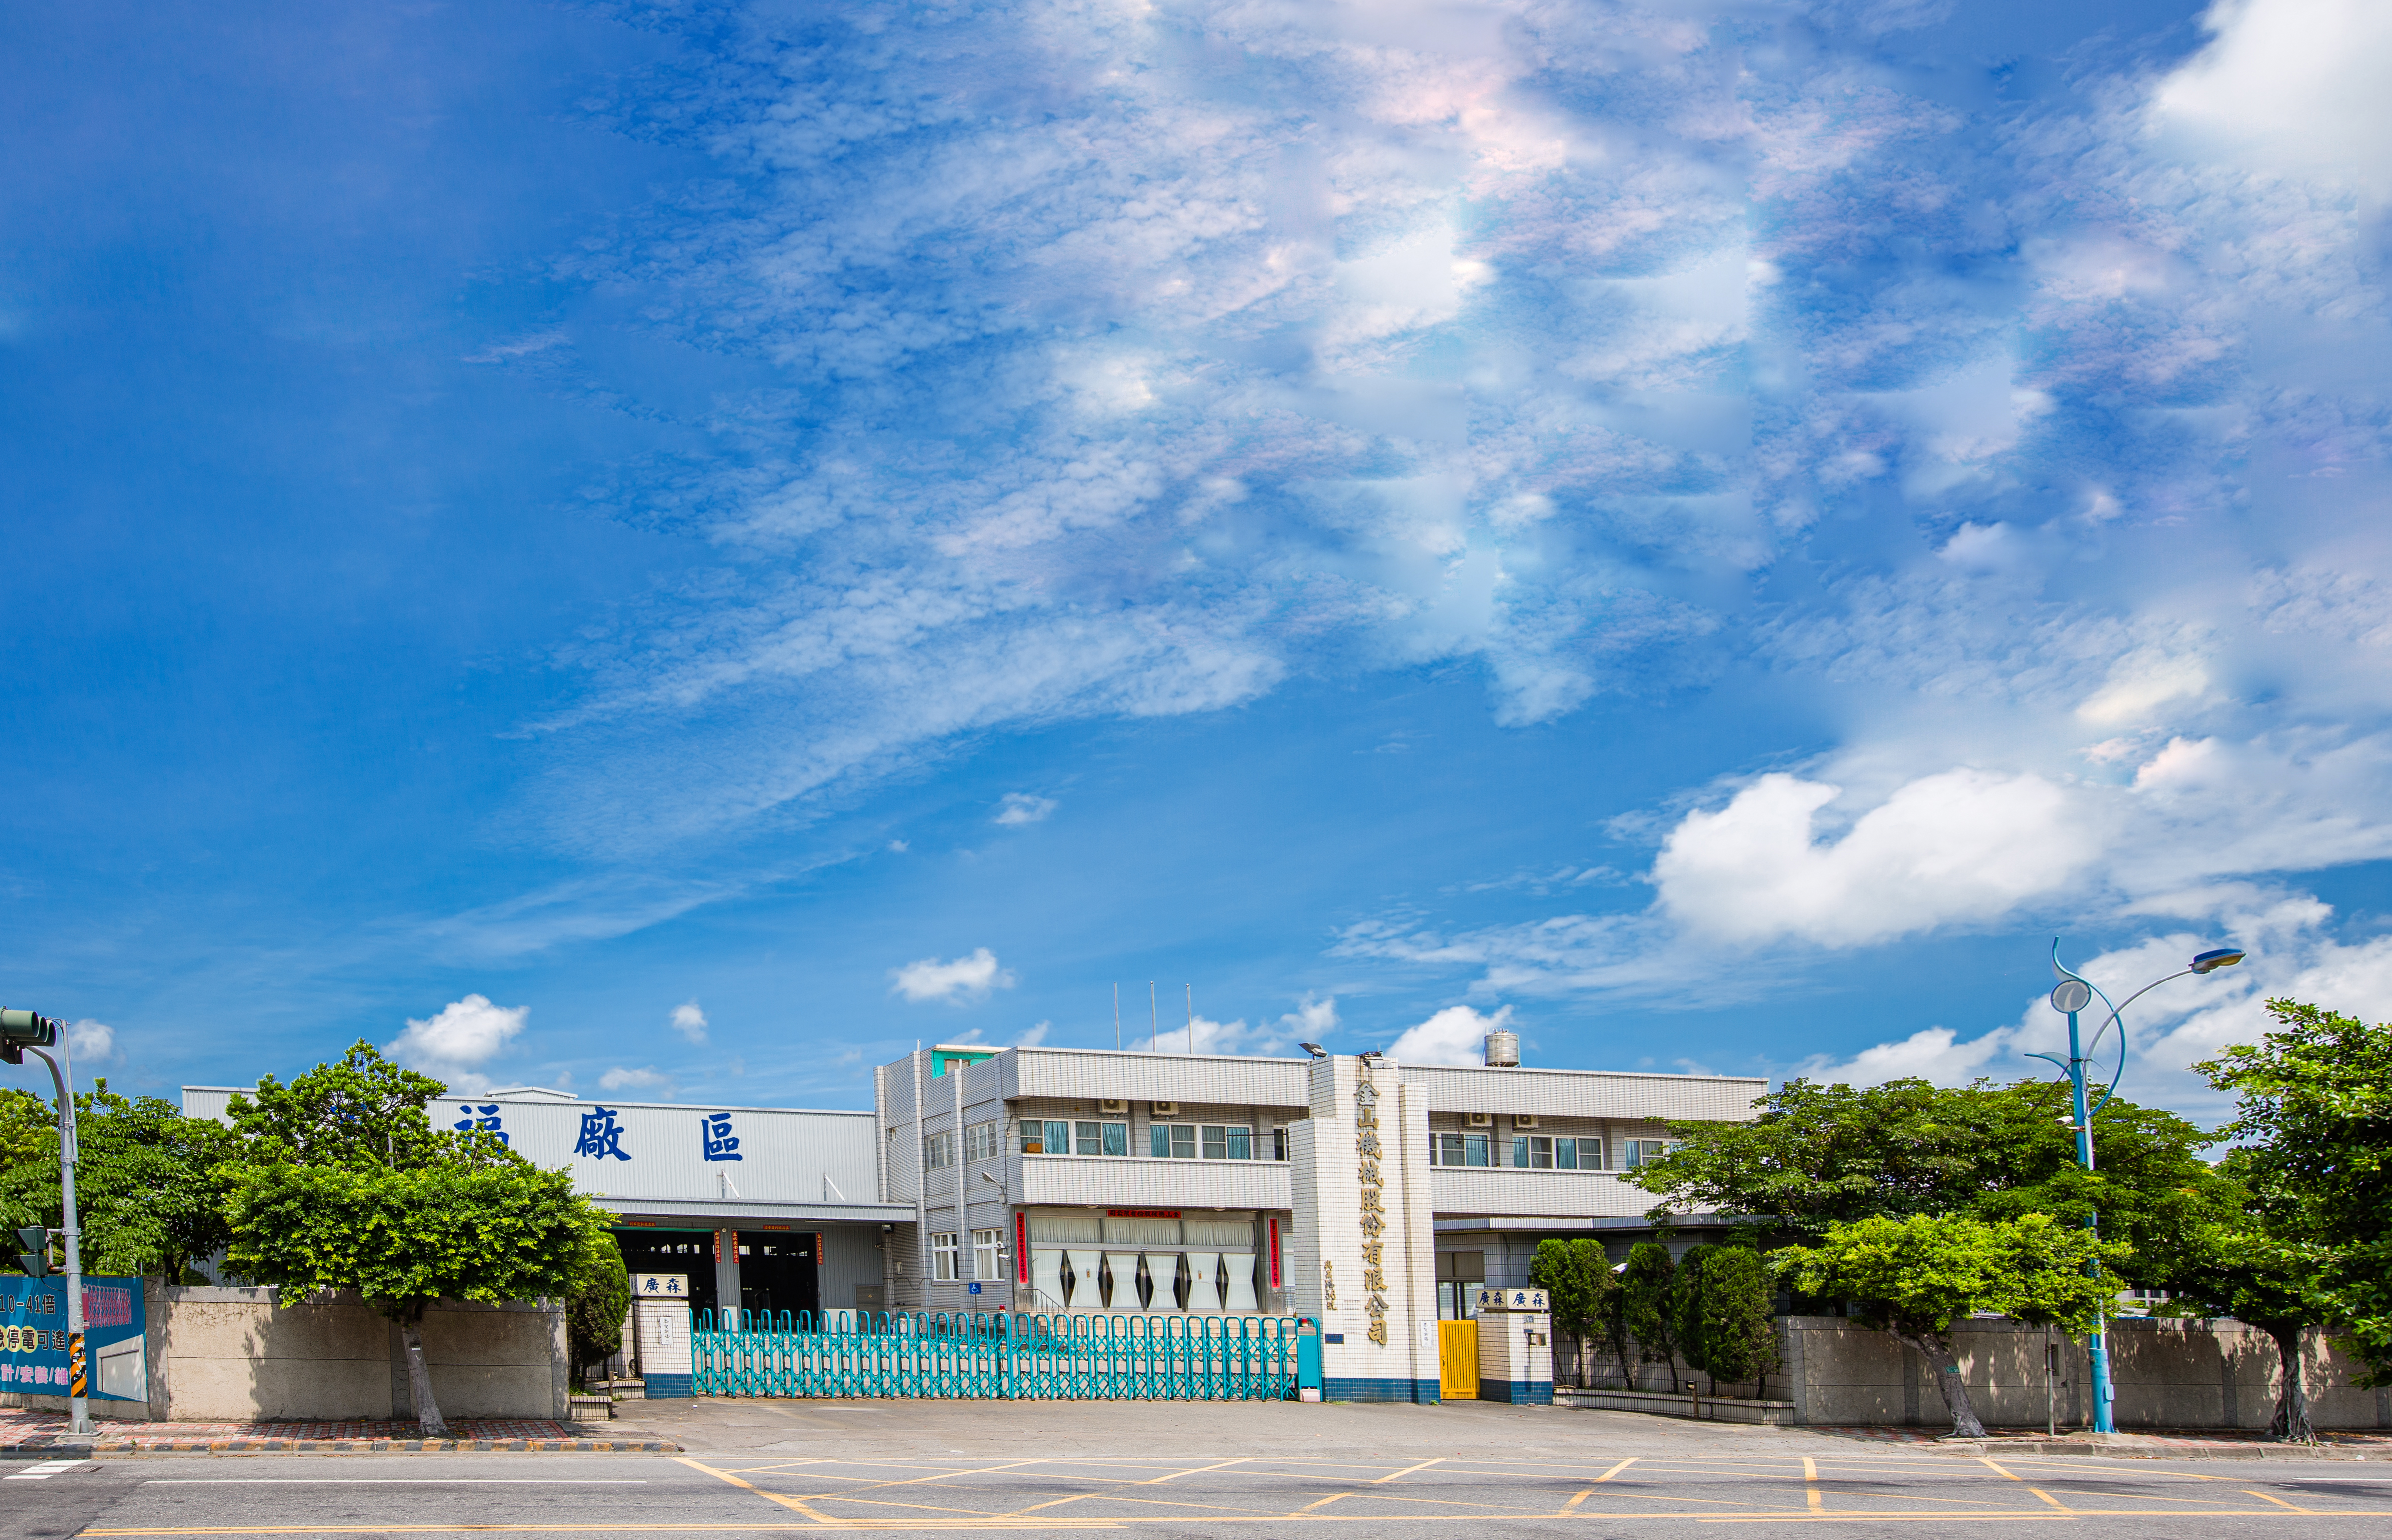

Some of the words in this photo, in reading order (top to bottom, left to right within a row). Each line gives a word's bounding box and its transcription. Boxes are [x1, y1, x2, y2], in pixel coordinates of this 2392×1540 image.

[1354, 1080, 1389, 1345] 金山機械股份有限公司
[643, 1277, 682, 1294] 廣森
[1479, 1291, 1504, 1306] 廣森
[1512, 1292, 1546, 1307] 廣森
[0, 1329, 70, 1351] 停電可遙
[0, 1364, 71, 1386] 計/安裝/維
